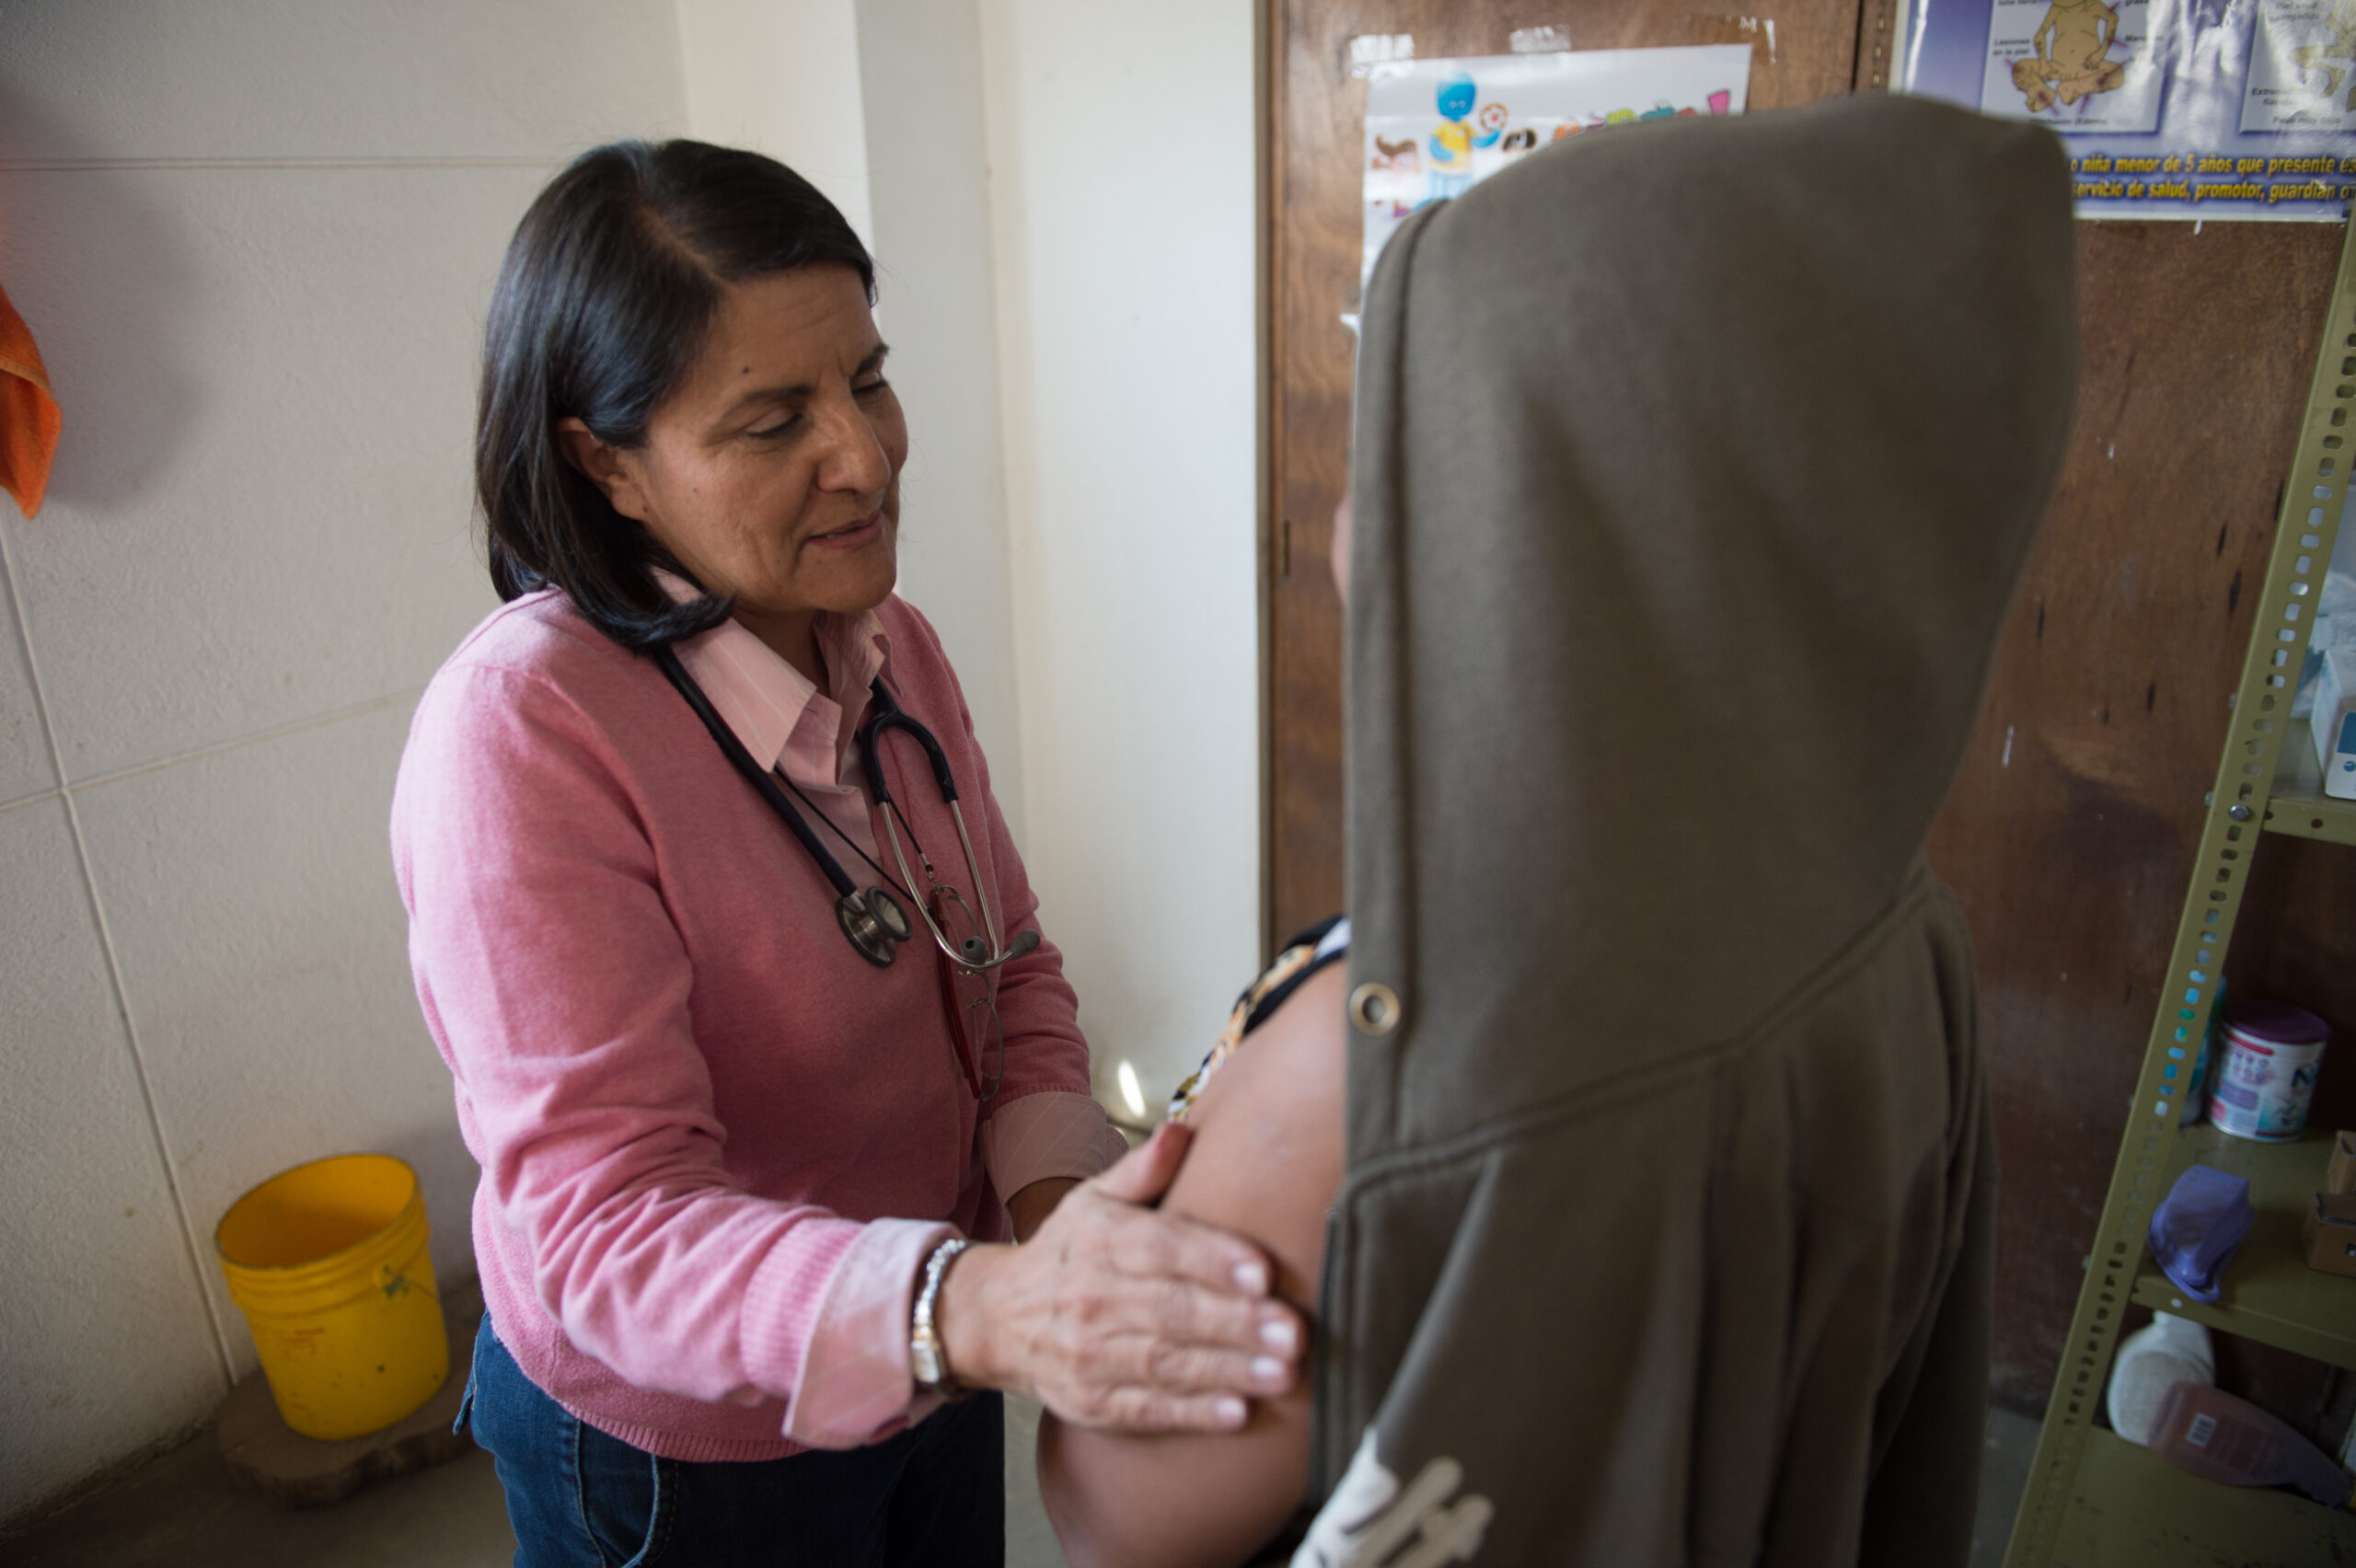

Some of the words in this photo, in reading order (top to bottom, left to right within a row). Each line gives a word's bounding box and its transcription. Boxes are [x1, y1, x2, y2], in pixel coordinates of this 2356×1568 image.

[2081, 154, 2111, 172] niña
[2115, 158, 2161, 172] menor
[2163, 154, 2182, 172] de
[2185, 153, 2197, 173] 5
[2198, 153, 2233, 172] años
[2236, 157, 2265, 178] que
[2268, 155, 2336, 179] presente
[2127, 179, 2145, 198] de
[2149, 179, 2190, 202] salud,
[2194, 180, 2265, 203] promotor,
